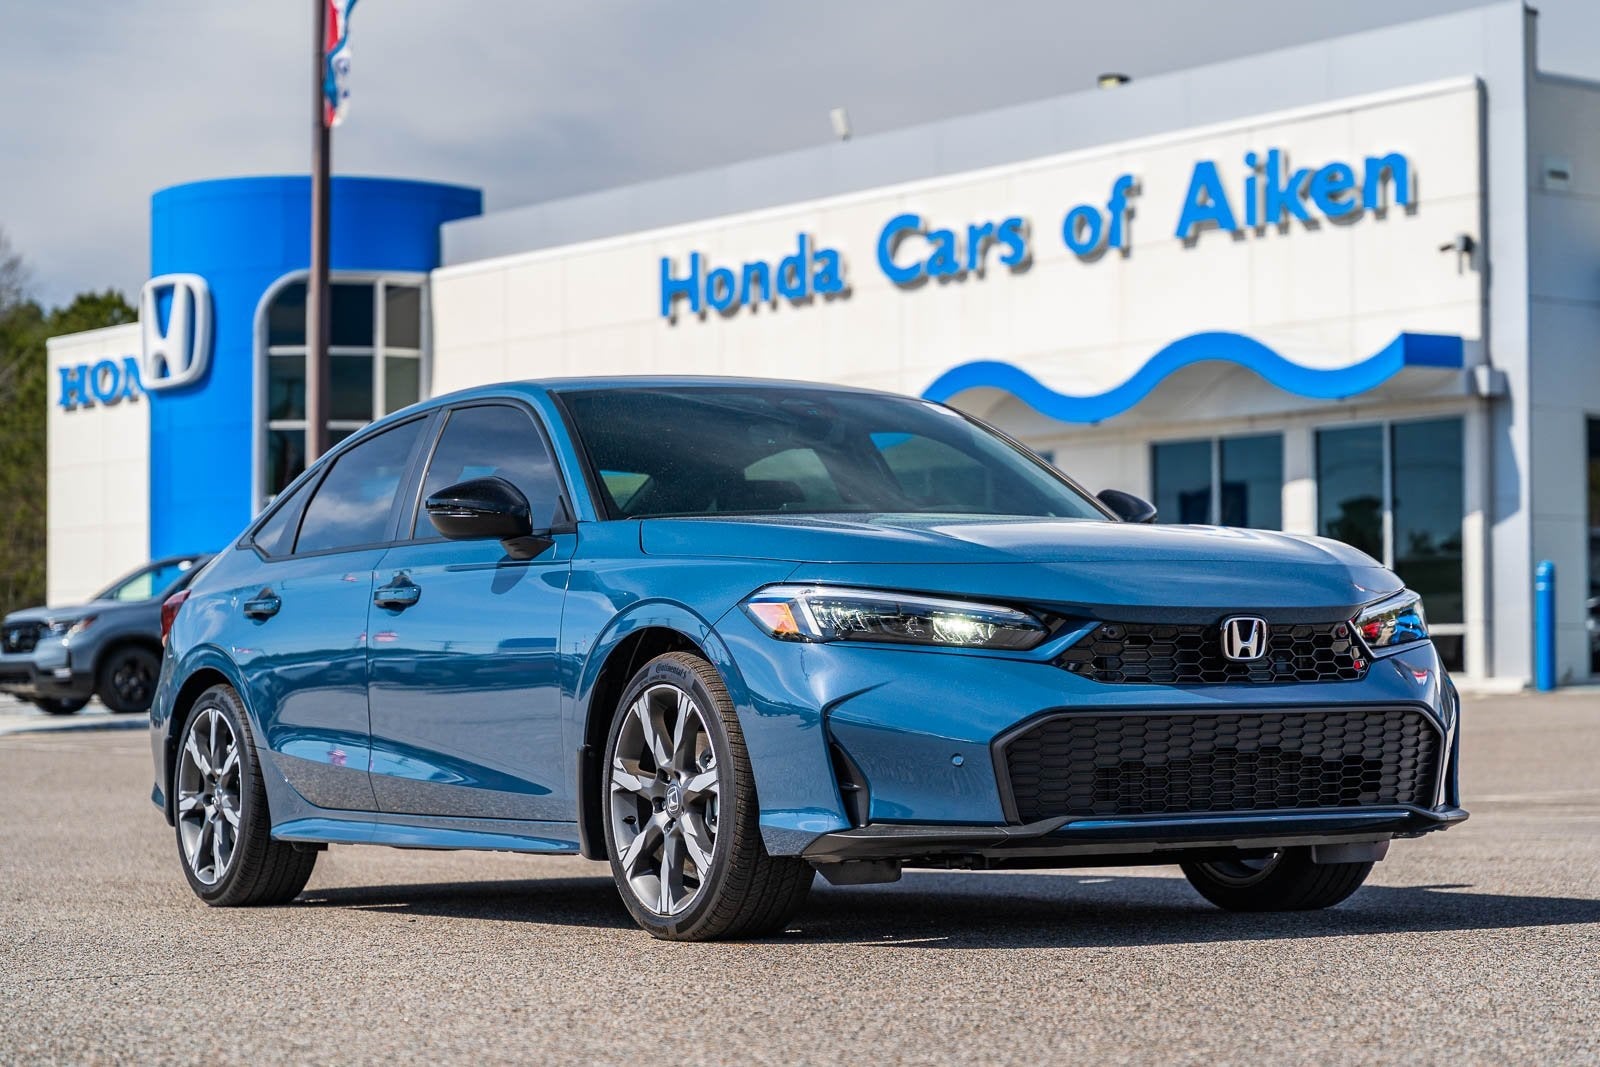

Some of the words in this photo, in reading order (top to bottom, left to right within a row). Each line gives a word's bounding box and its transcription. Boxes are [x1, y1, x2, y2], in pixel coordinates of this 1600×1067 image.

[660, 232, 844, 317] Honda
[876, 213, 1026, 283] Cars
[1062, 174, 1134, 255] of
[1175, 148, 1410, 238] Aiken
